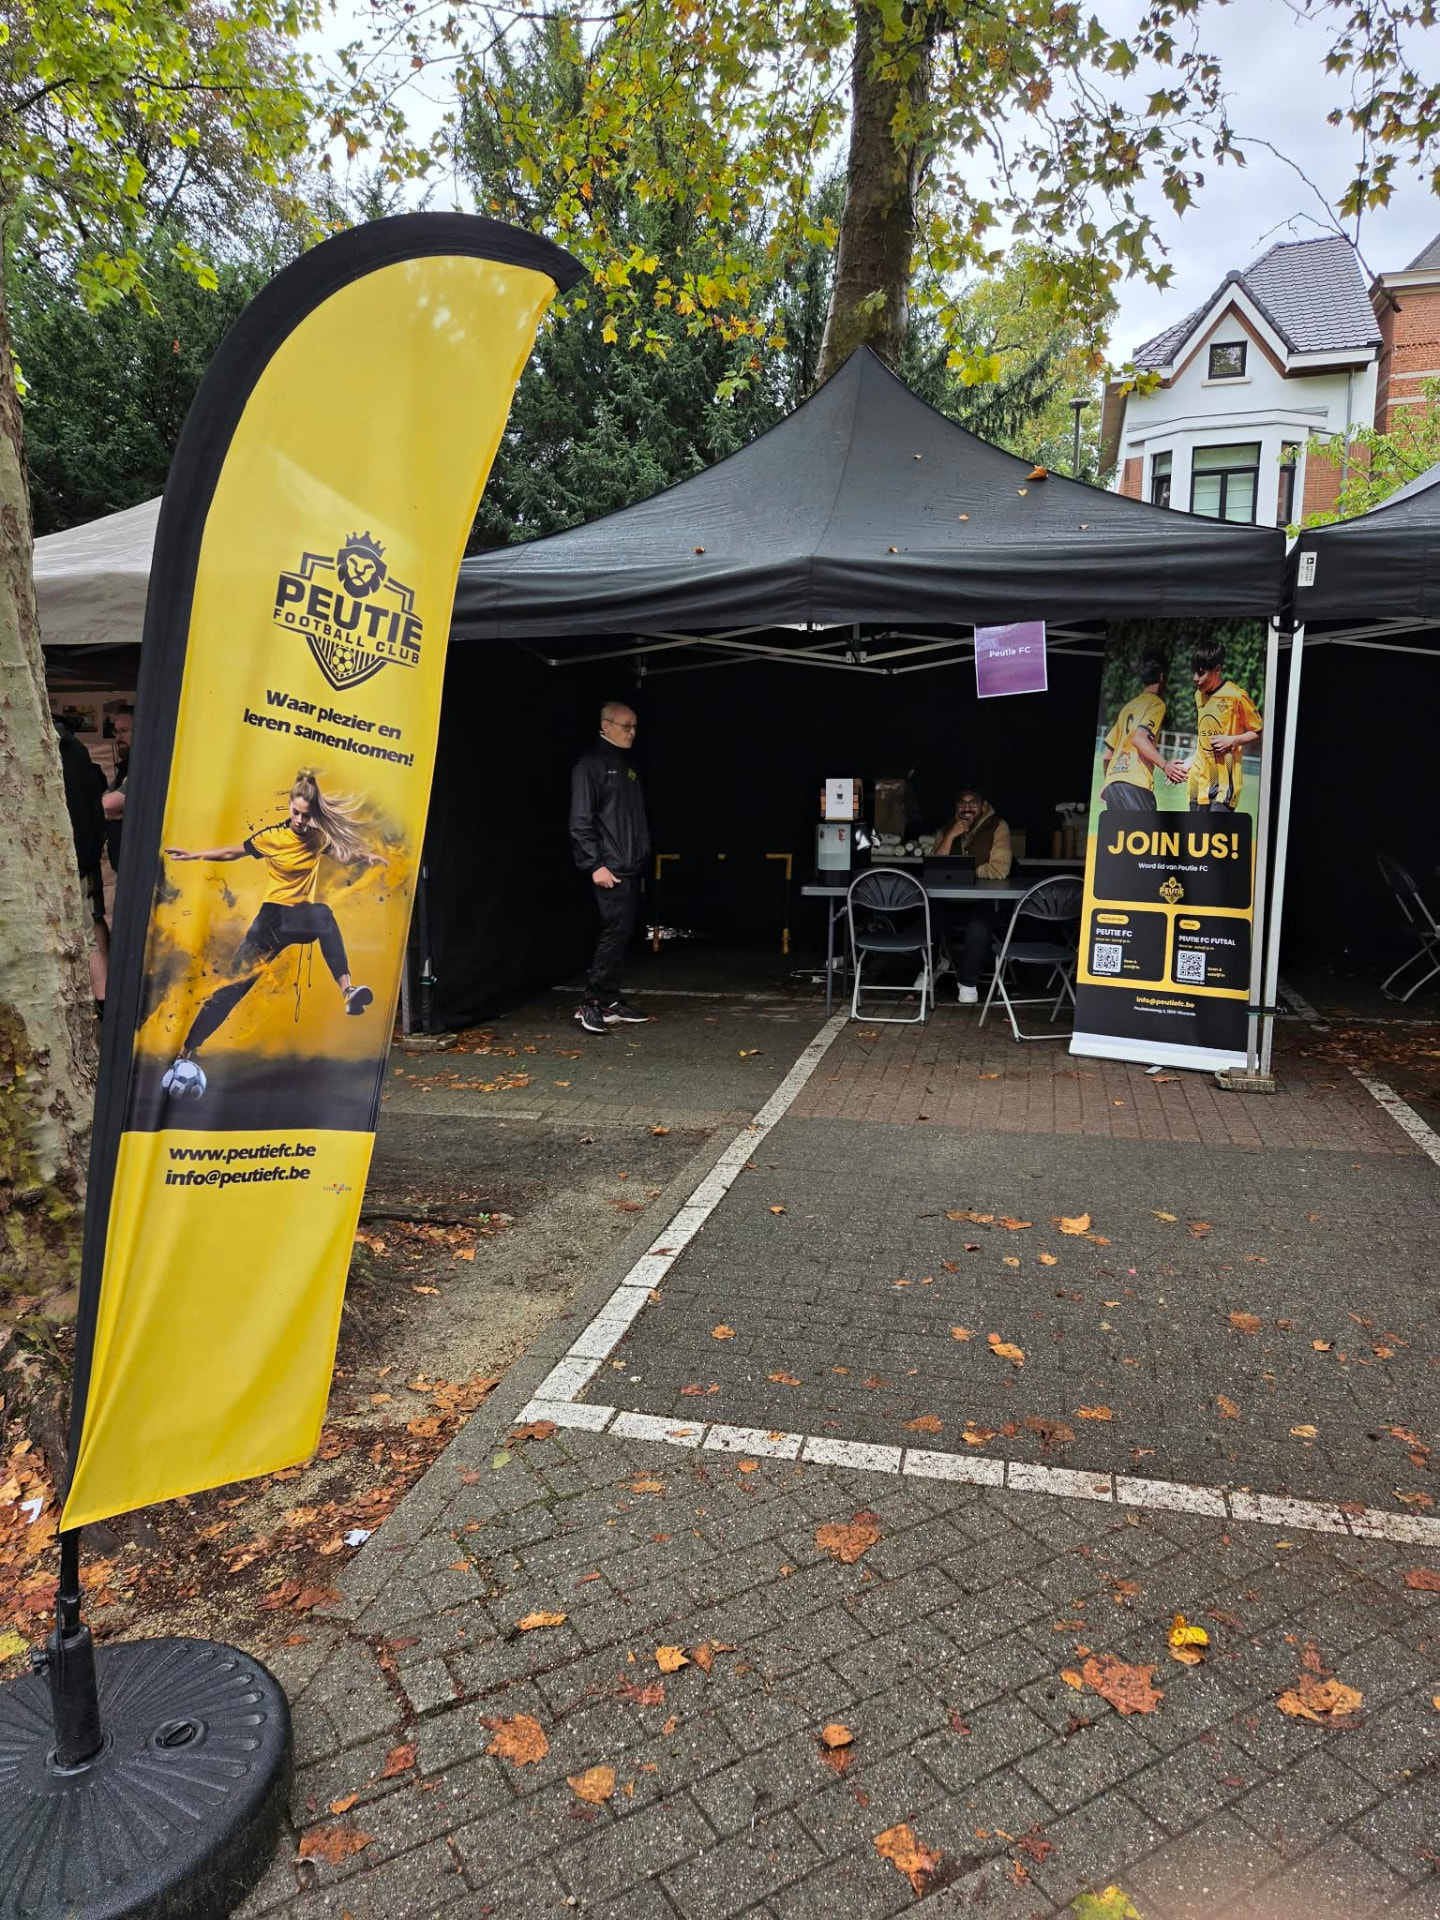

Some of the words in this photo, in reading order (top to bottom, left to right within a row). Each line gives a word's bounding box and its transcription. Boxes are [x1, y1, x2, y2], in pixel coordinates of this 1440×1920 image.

[275, 574, 423, 653] PEUTIE
[273, 608, 365, 648] FOOTBALL
[376, 641, 420, 664] CLUB
[989, 647, 1017, 658] Peutie
[1018, 646, 1031, 655] FC
[266, 689, 317, 715] Waar
[317, 707, 376, 733] plezier
[378, 723, 402, 740] en
[243, 708, 291, 733] leren
[293, 724, 415, 767] samenkomen!
[1107, 830, 1180, 857] JOIN
[1187, 832, 1239, 860] US!
[1138, 862, 1157, 870] Word
[1157, 862, 1165, 870] lid
[1177, 864, 1198, 872] Peutie
[1095, 928, 1121, 937] PEUTIE
[1122, 929, 1133, 937] FC
[1178, 935, 1200, 943] PEUTIE
[1200, 936, 1210, 944] FC
[1210, 937, 1236, 946] FUTSAL
[1136, 995, 1195, 1008] info@peutiefc.be
[168, 1143, 317, 1164] www.peutiefc.be
[164, 1165, 311, 1188] info@peutiefc.be
